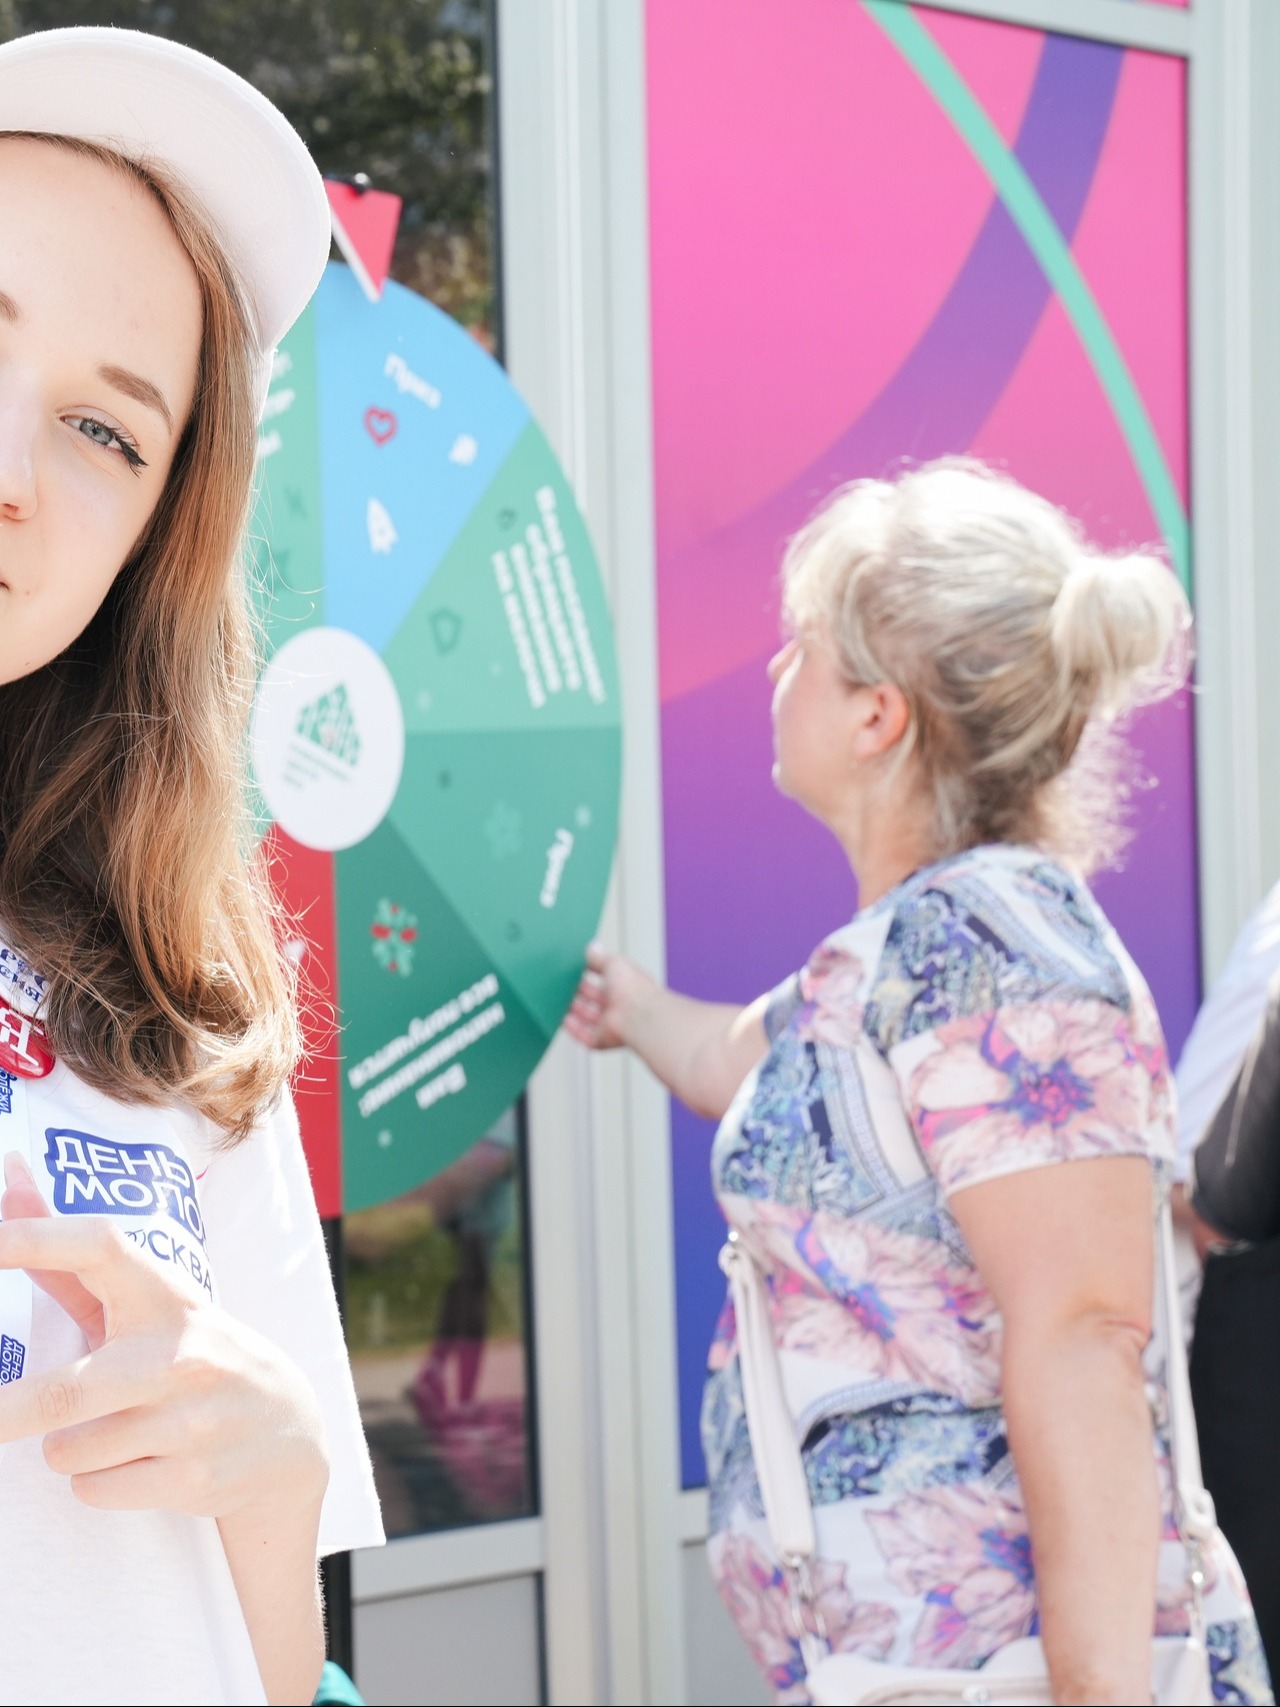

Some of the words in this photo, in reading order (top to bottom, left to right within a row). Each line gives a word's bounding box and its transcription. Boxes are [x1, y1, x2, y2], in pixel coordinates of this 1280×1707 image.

[55, 1136, 191, 1189] ДЕНЬ
[65, 1172, 206, 1246] МОЛО
[10, 1341, 24, 1381] ДЕНЬ
